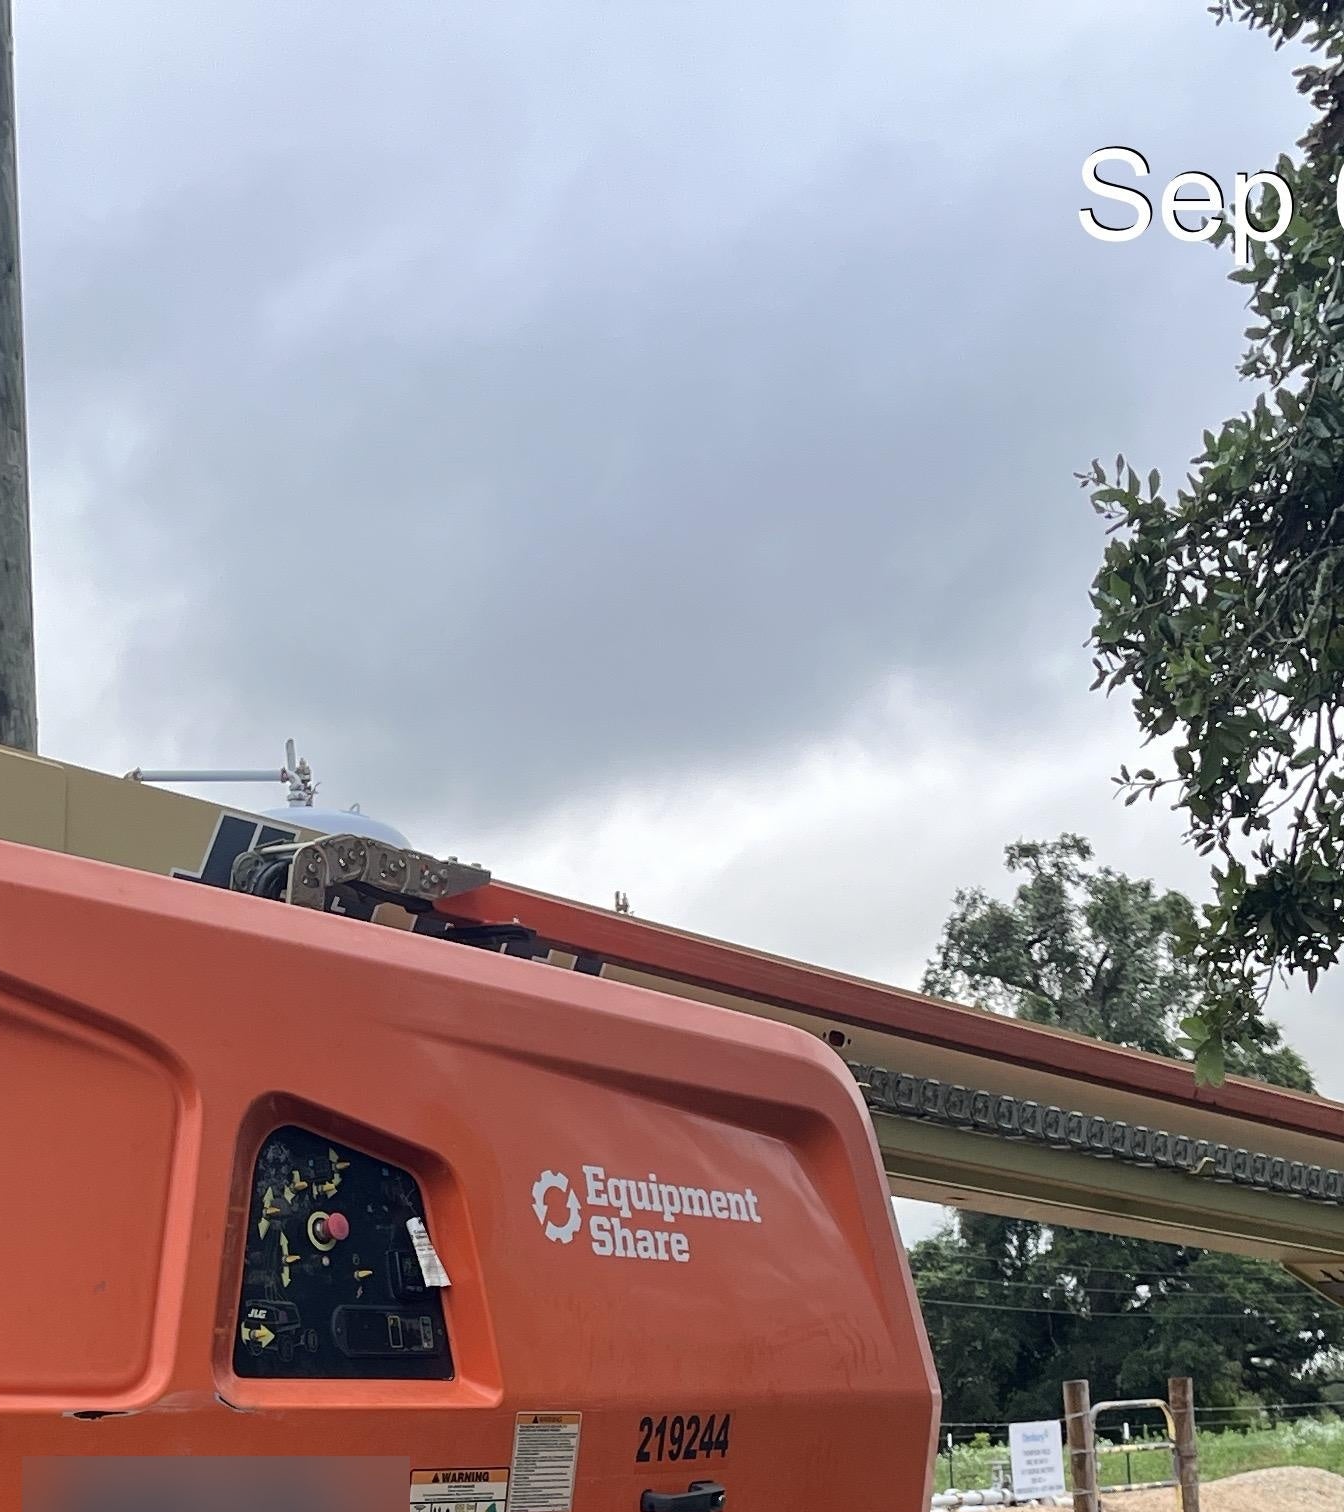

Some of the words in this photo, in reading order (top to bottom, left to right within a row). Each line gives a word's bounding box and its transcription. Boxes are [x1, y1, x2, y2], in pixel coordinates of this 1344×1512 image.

[582, 1165, 762, 1223] Equipment
[588, 1215, 691, 1262] Share
[247, 1308, 267, 1319] JLG
[636, 1413, 731, 1463] 219244
[442, 1471, 489, 1483] WARNING
